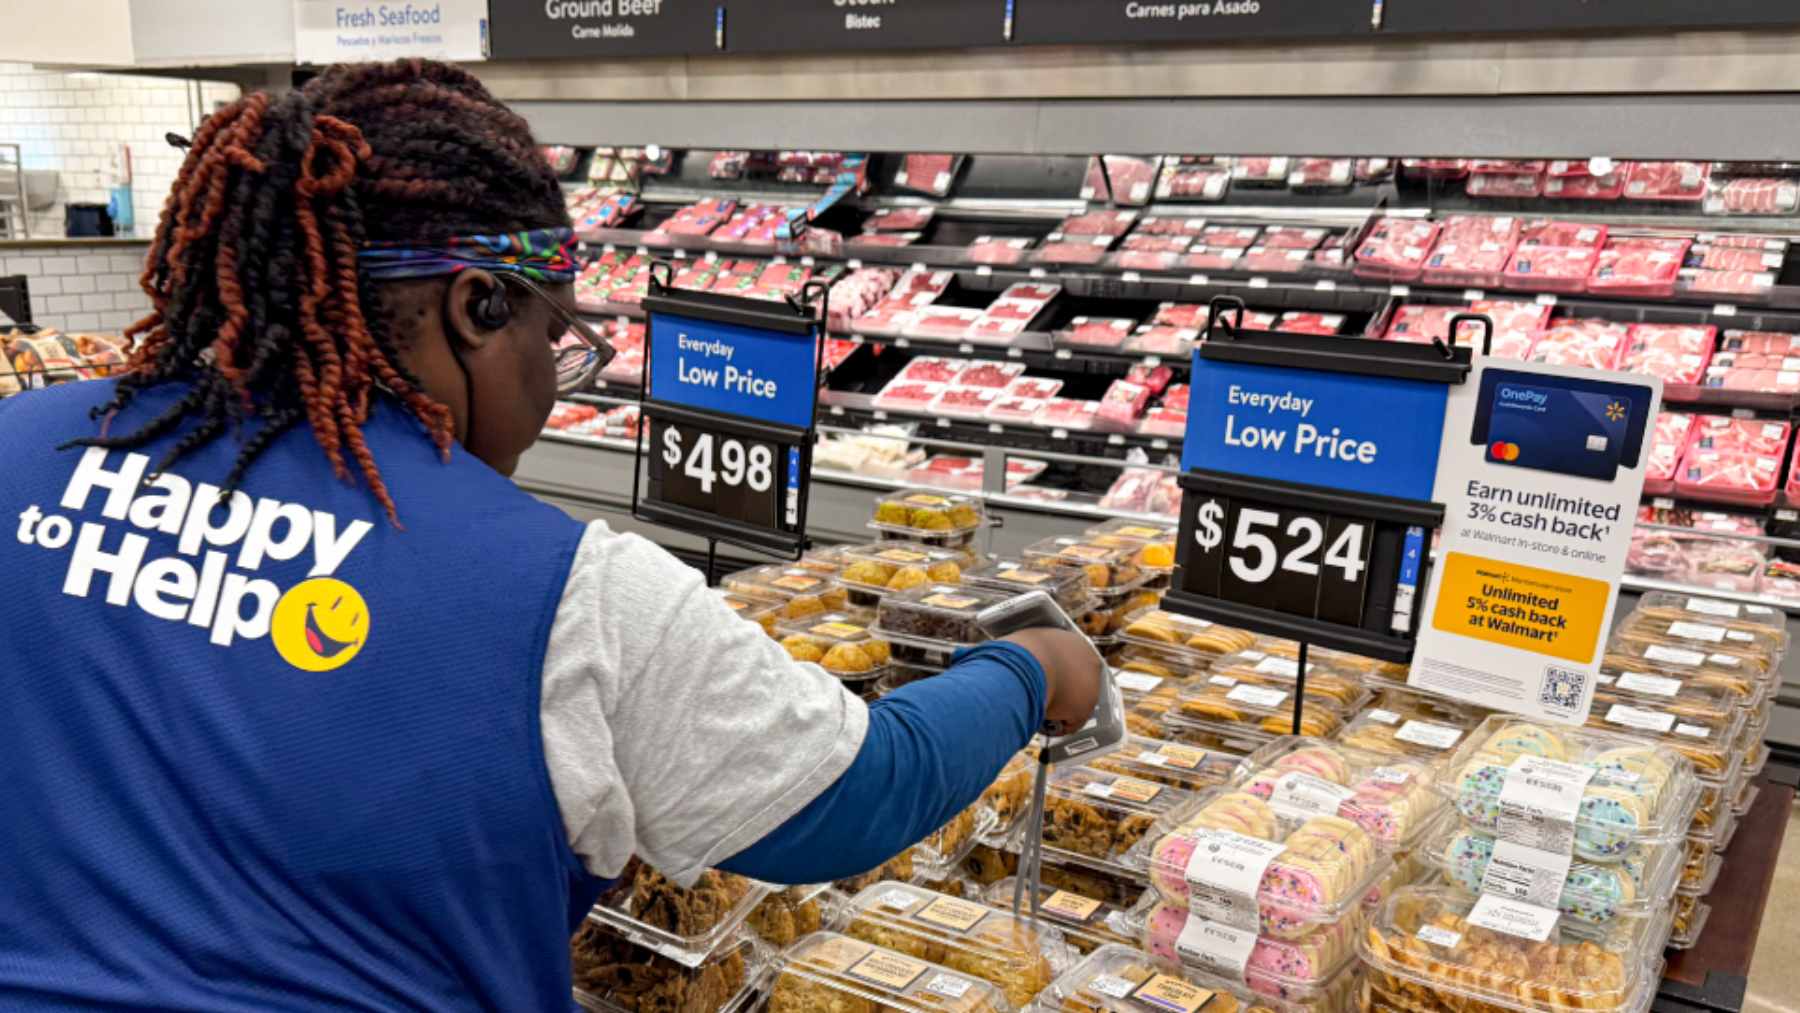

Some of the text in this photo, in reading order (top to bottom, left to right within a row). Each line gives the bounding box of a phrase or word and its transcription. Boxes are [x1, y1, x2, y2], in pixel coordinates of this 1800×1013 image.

[336, 3, 441, 27] Fresh Seafood
[545, 0, 663, 19] Ground Beef
[845, 13, 881, 29] Bistec
[1125, 0, 1260, 20] Carnes para Asado
[572, 24, 635, 38] Carne Molida
[679, 334, 734, 361] Everyday
[679, 358, 777, 399] Low Price
[1228, 385, 1314, 415] Everyday
[1501, 388, 1547, 405] OnePay
[1224, 415, 1377, 464] Low Price
[60, 446, 374, 578] Happy
[1467, 480, 1621, 521] Earn unlimited
[1467, 502, 1496, 522] 3%
[1500, 510, 1547, 532] cash
[1461, 528, 1471, 537] at
[1473, 530, 1516, 546] Walmart
[1562, 547, 1569, 556] &
[1571, 551, 1606, 563] online
[17, 505, 281, 647] to Help
[1482, 583, 1559, 610] Unlimited
[1467, 596, 1567, 629] 5% cash back
[1469, 614, 1484, 627] at
